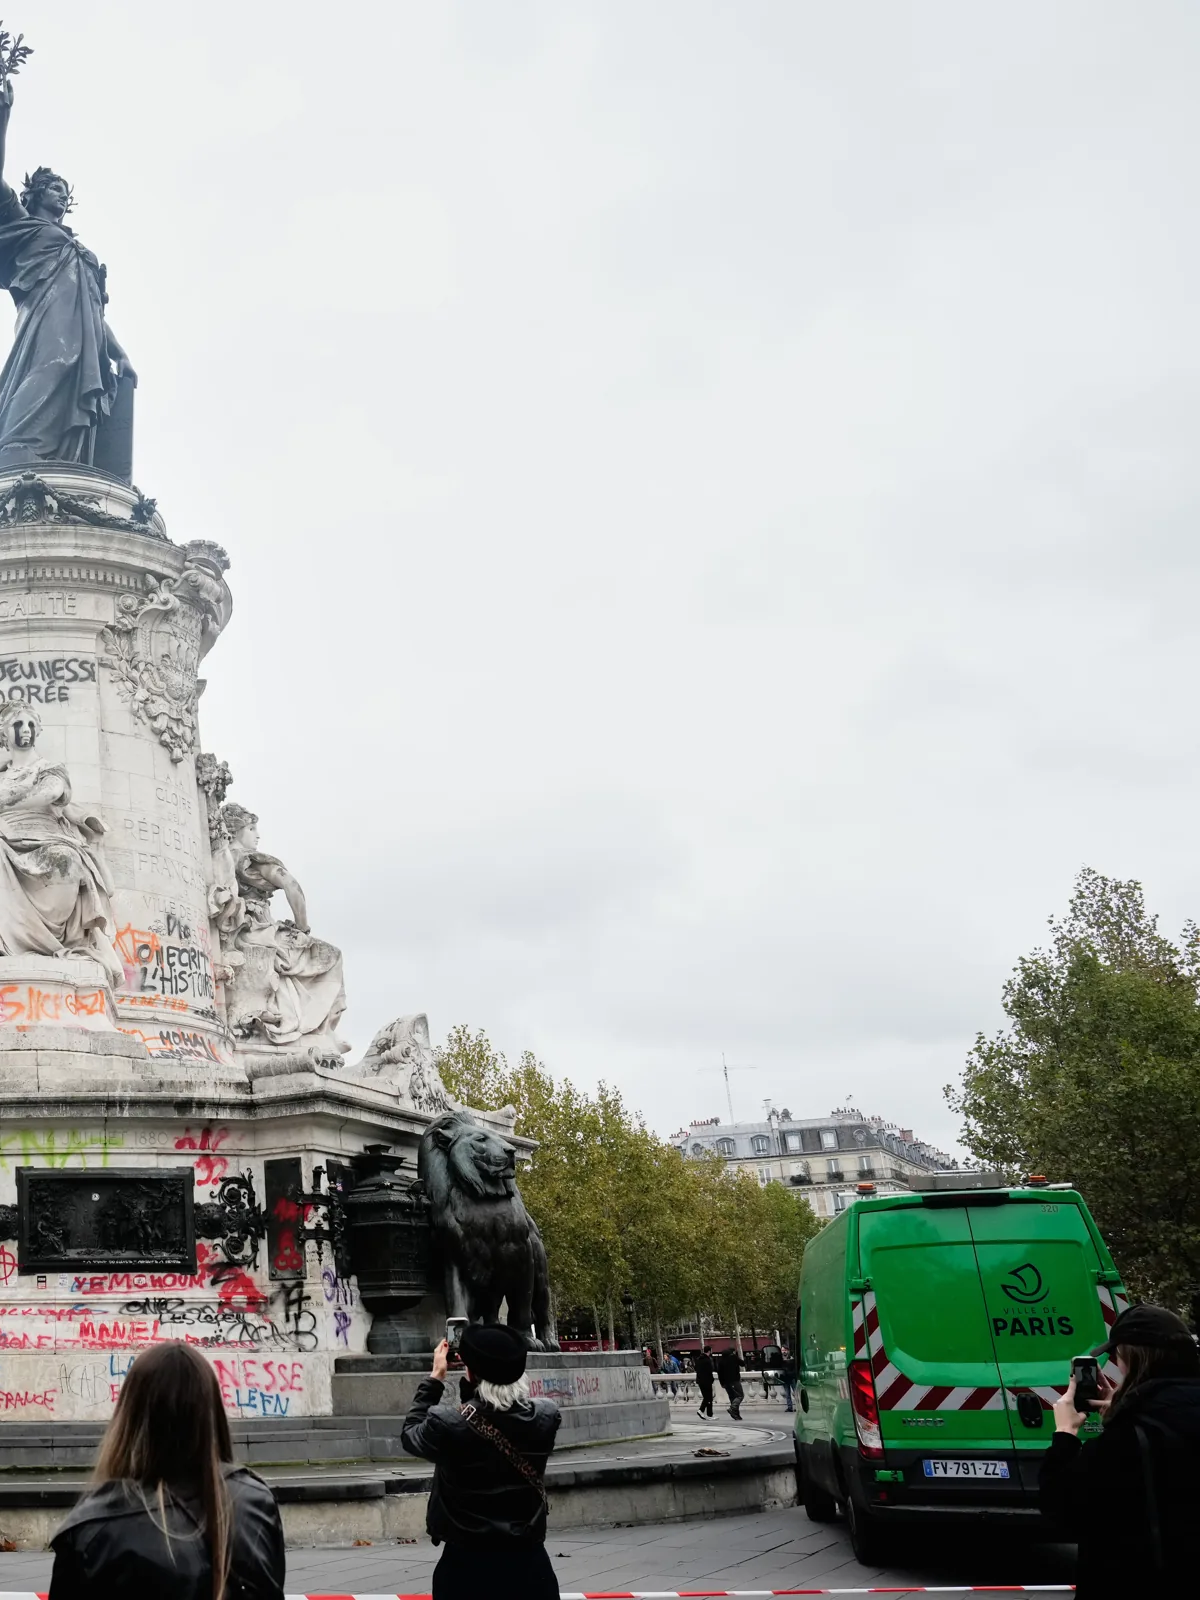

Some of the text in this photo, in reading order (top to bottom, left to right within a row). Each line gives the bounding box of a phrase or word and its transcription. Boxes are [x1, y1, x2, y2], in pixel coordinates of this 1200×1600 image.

[134, 1130, 169, 1145] 1880
[1040, 1205, 1059, 1213] 320
[1003, 1306, 1057, 1315] VILLE DE
[992, 1316, 1075, 1337] PARIS
[933, 1461, 1000, 1476] FV-791-ZZ
